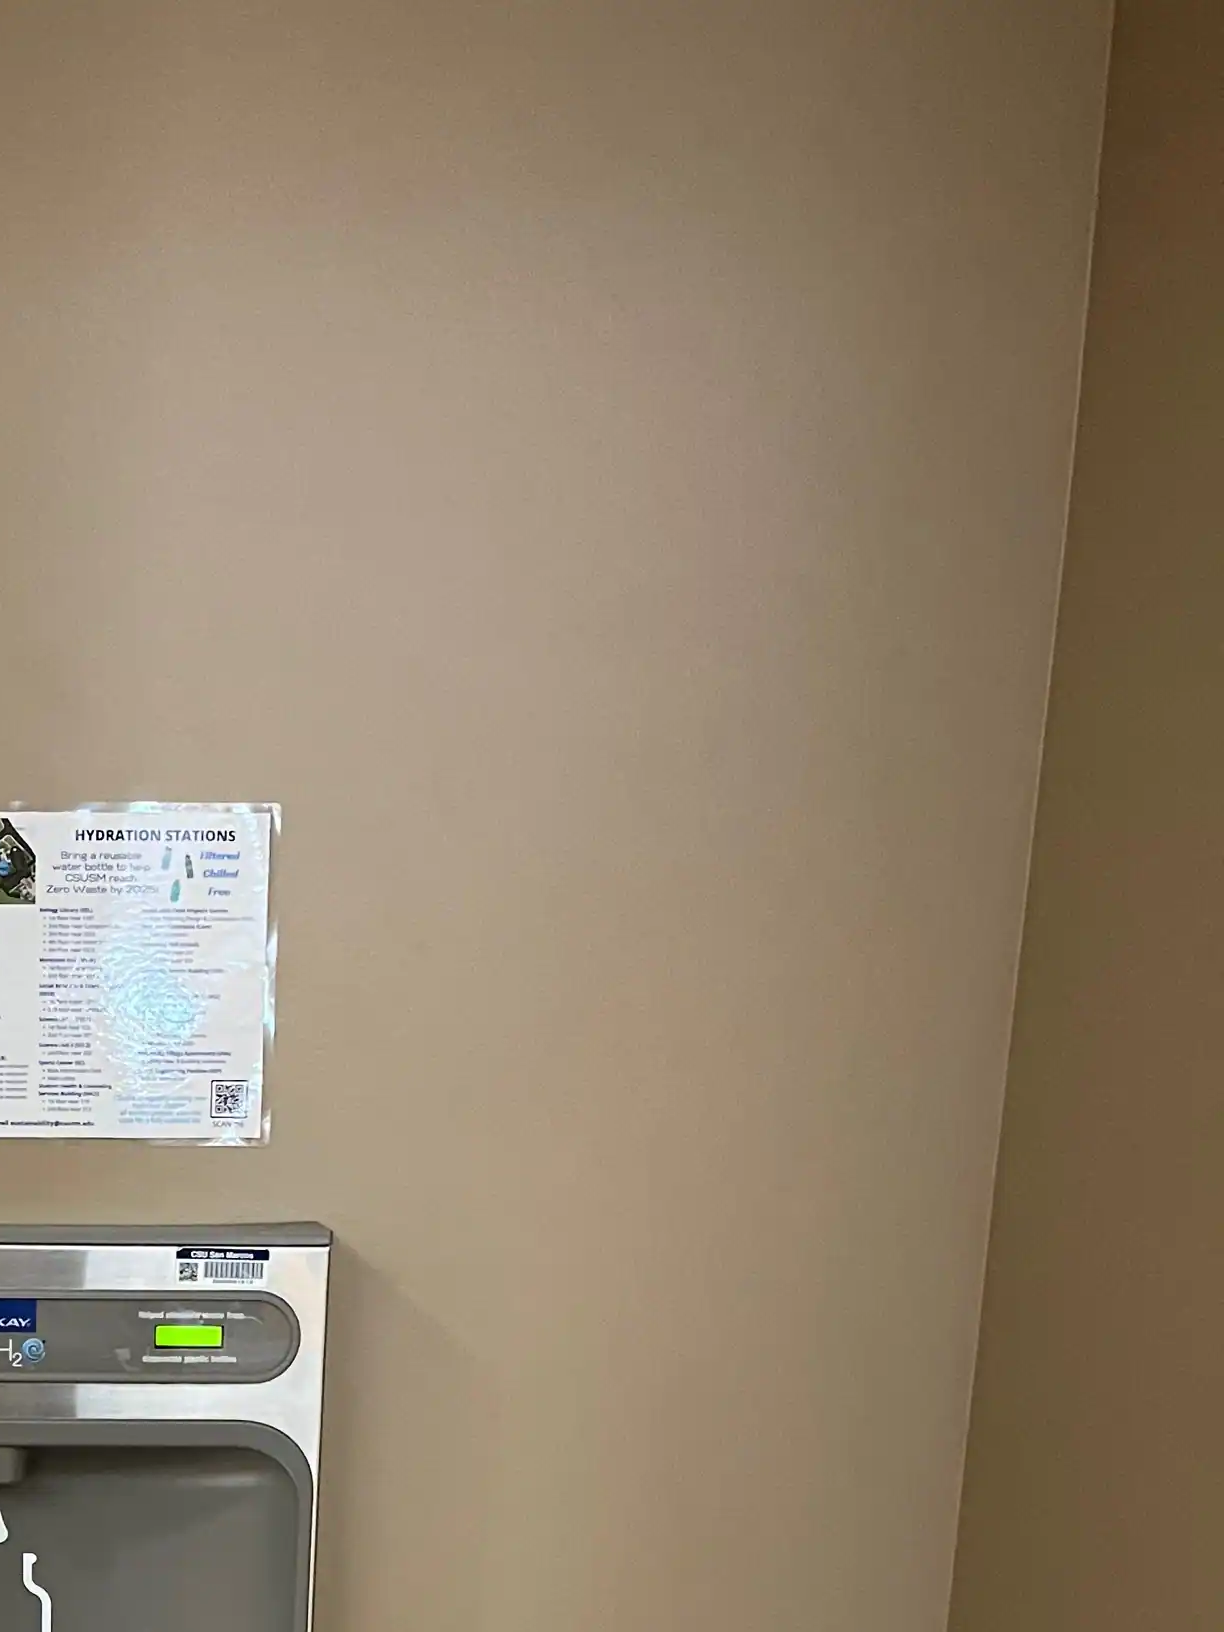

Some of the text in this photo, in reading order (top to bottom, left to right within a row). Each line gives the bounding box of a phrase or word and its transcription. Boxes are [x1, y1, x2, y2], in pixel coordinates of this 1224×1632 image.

[75, 829, 236, 841] HYDRATION STATIONS
[60, 850, 88, 861] Bring
[91, 852, 97, 860] a
[52, 863, 81, 871] water
[84, 862, 114, 871] bottle
[116, 862, 127, 871] to
[64, 873, 106, 883] CSUSM
[46, 884, 70, 894] Zero
[73, 884, 108, 894] Waste
[110, 884, 123, 896] by
[190, 1251, 208, 1259] CSU
[209, 1251, 224, 1259] San
